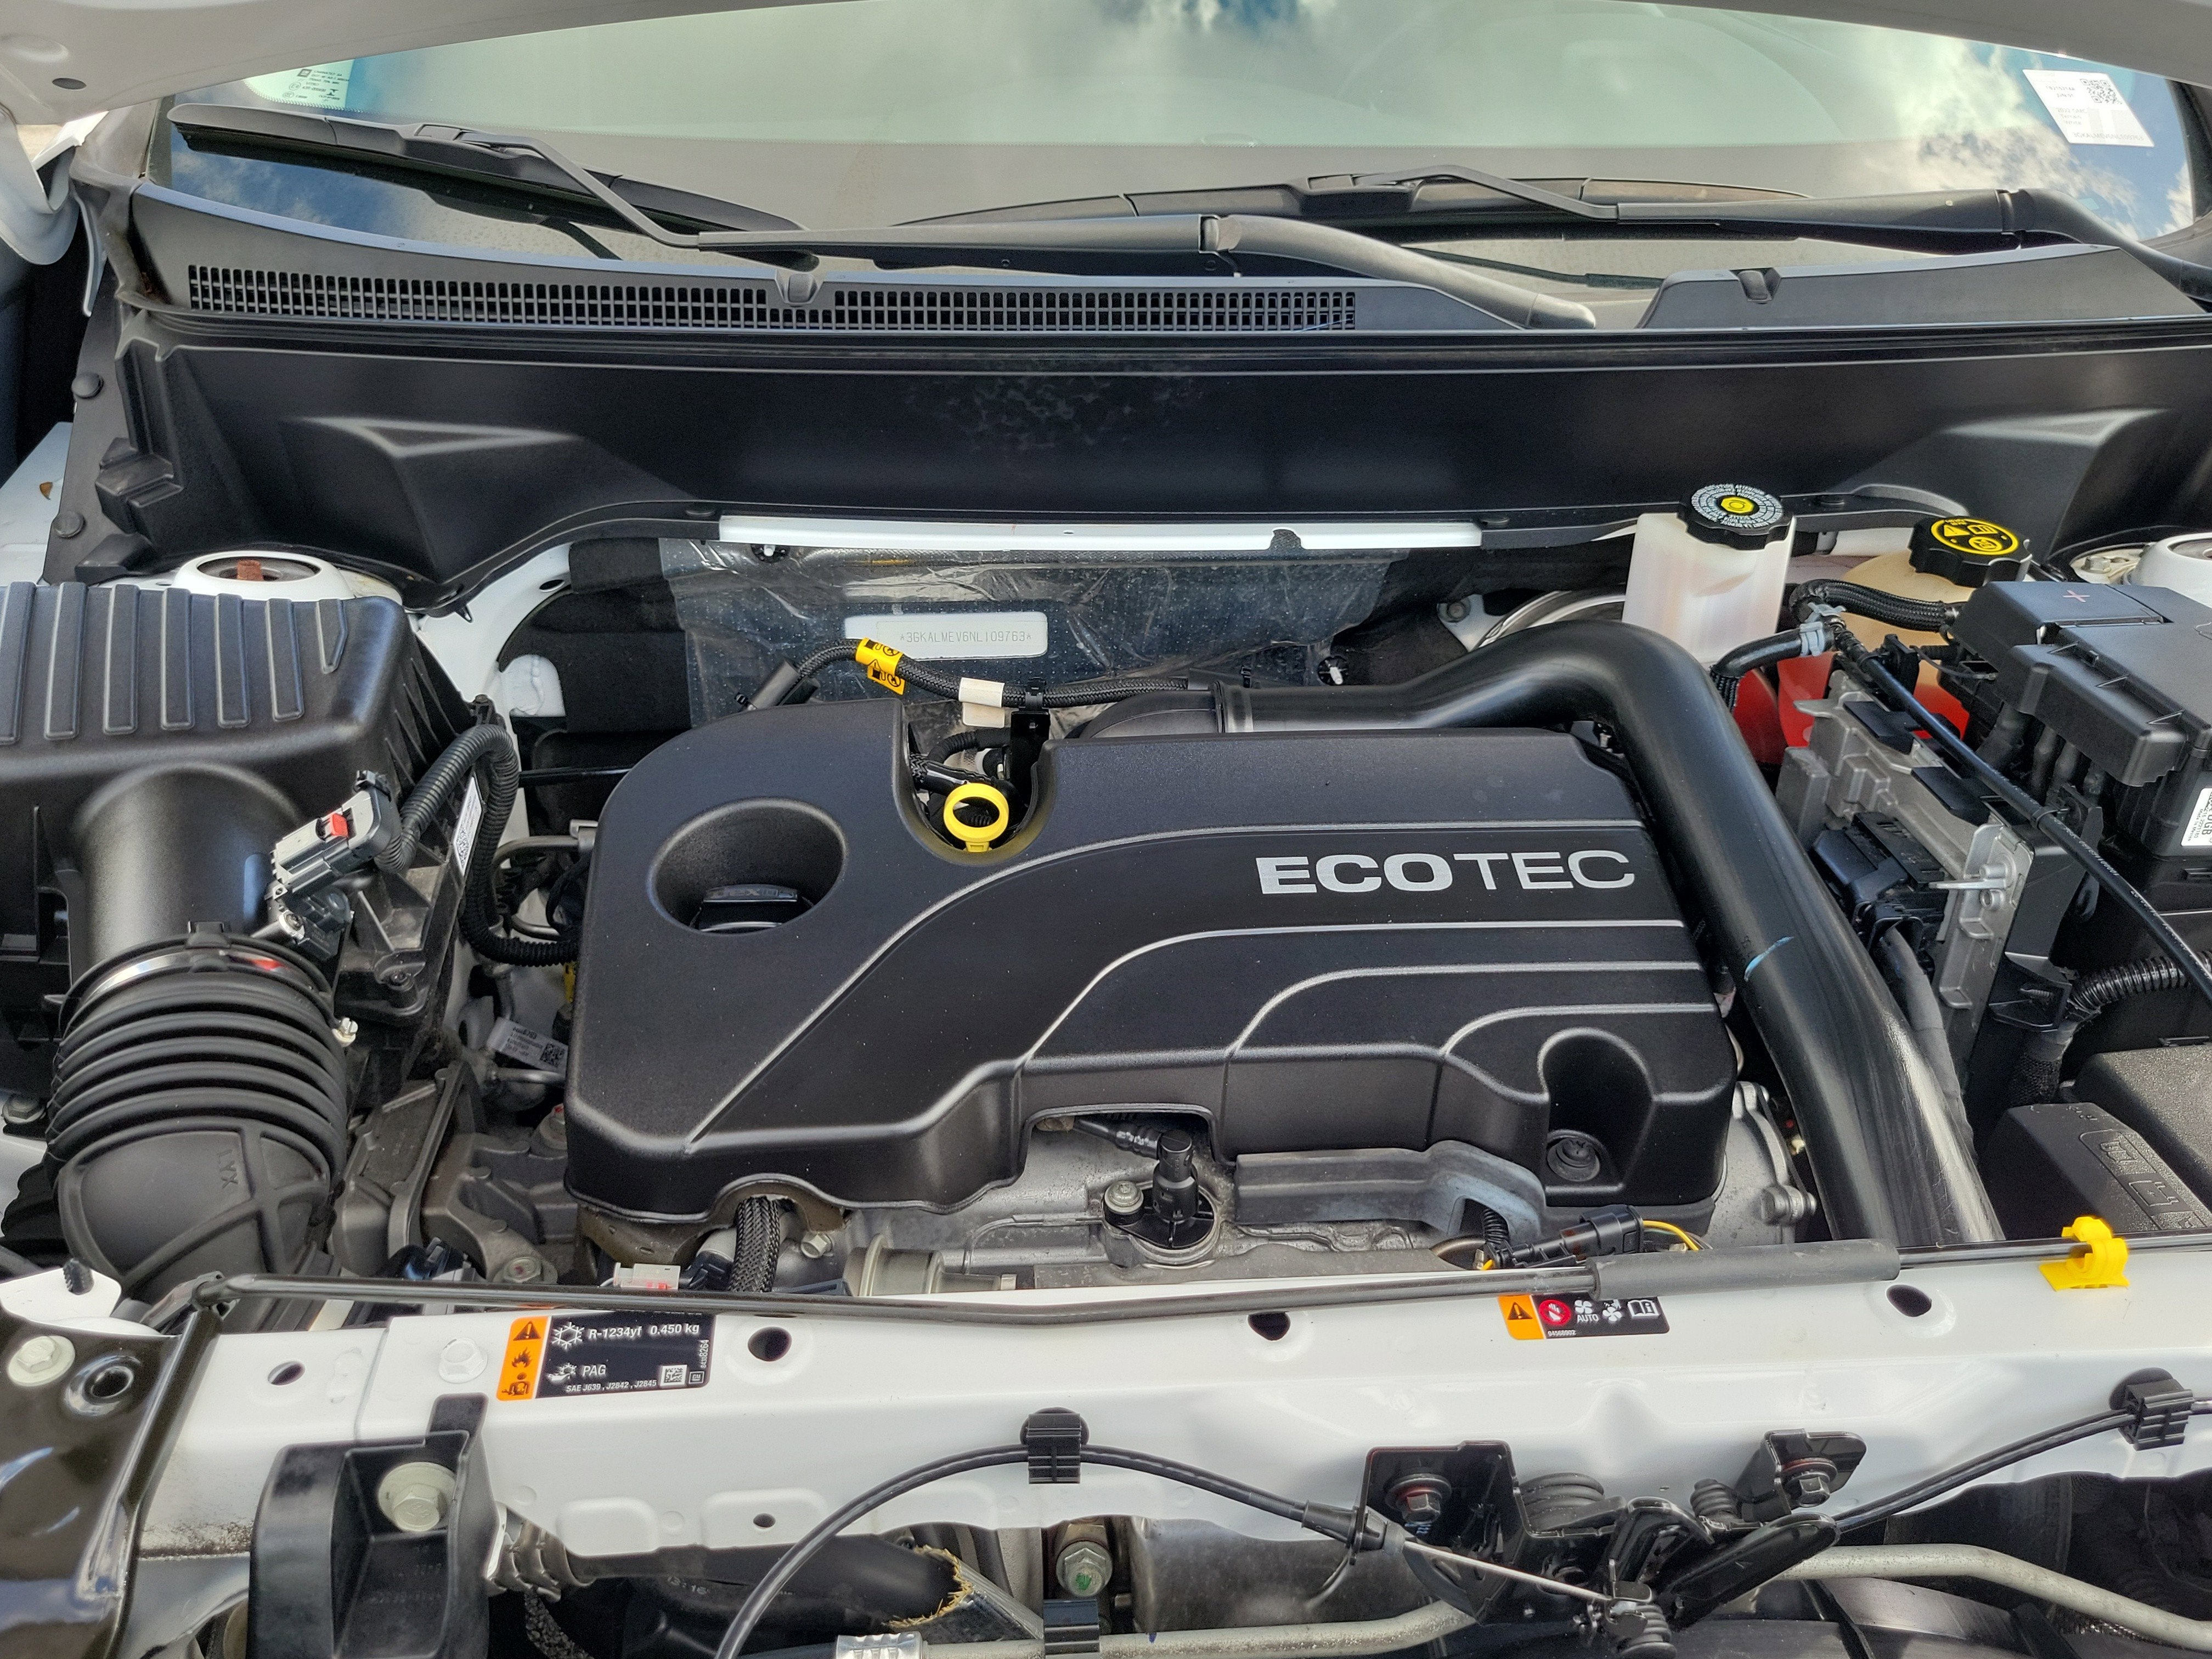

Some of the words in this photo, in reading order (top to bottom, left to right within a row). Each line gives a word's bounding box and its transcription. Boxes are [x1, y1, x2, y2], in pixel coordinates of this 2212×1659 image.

[1255, 850, 1635, 894] ECOTEC
[1577, 1314, 1599, 1323] AUTO
[588, 1326, 642, 1339] R-1234yf
[650, 1324, 682, 1335] 0.450
[685, 1323, 699, 1335] kg
[582, 1364, 606, 1376] PAG
[634, 1380, 657, 1388] J2845
